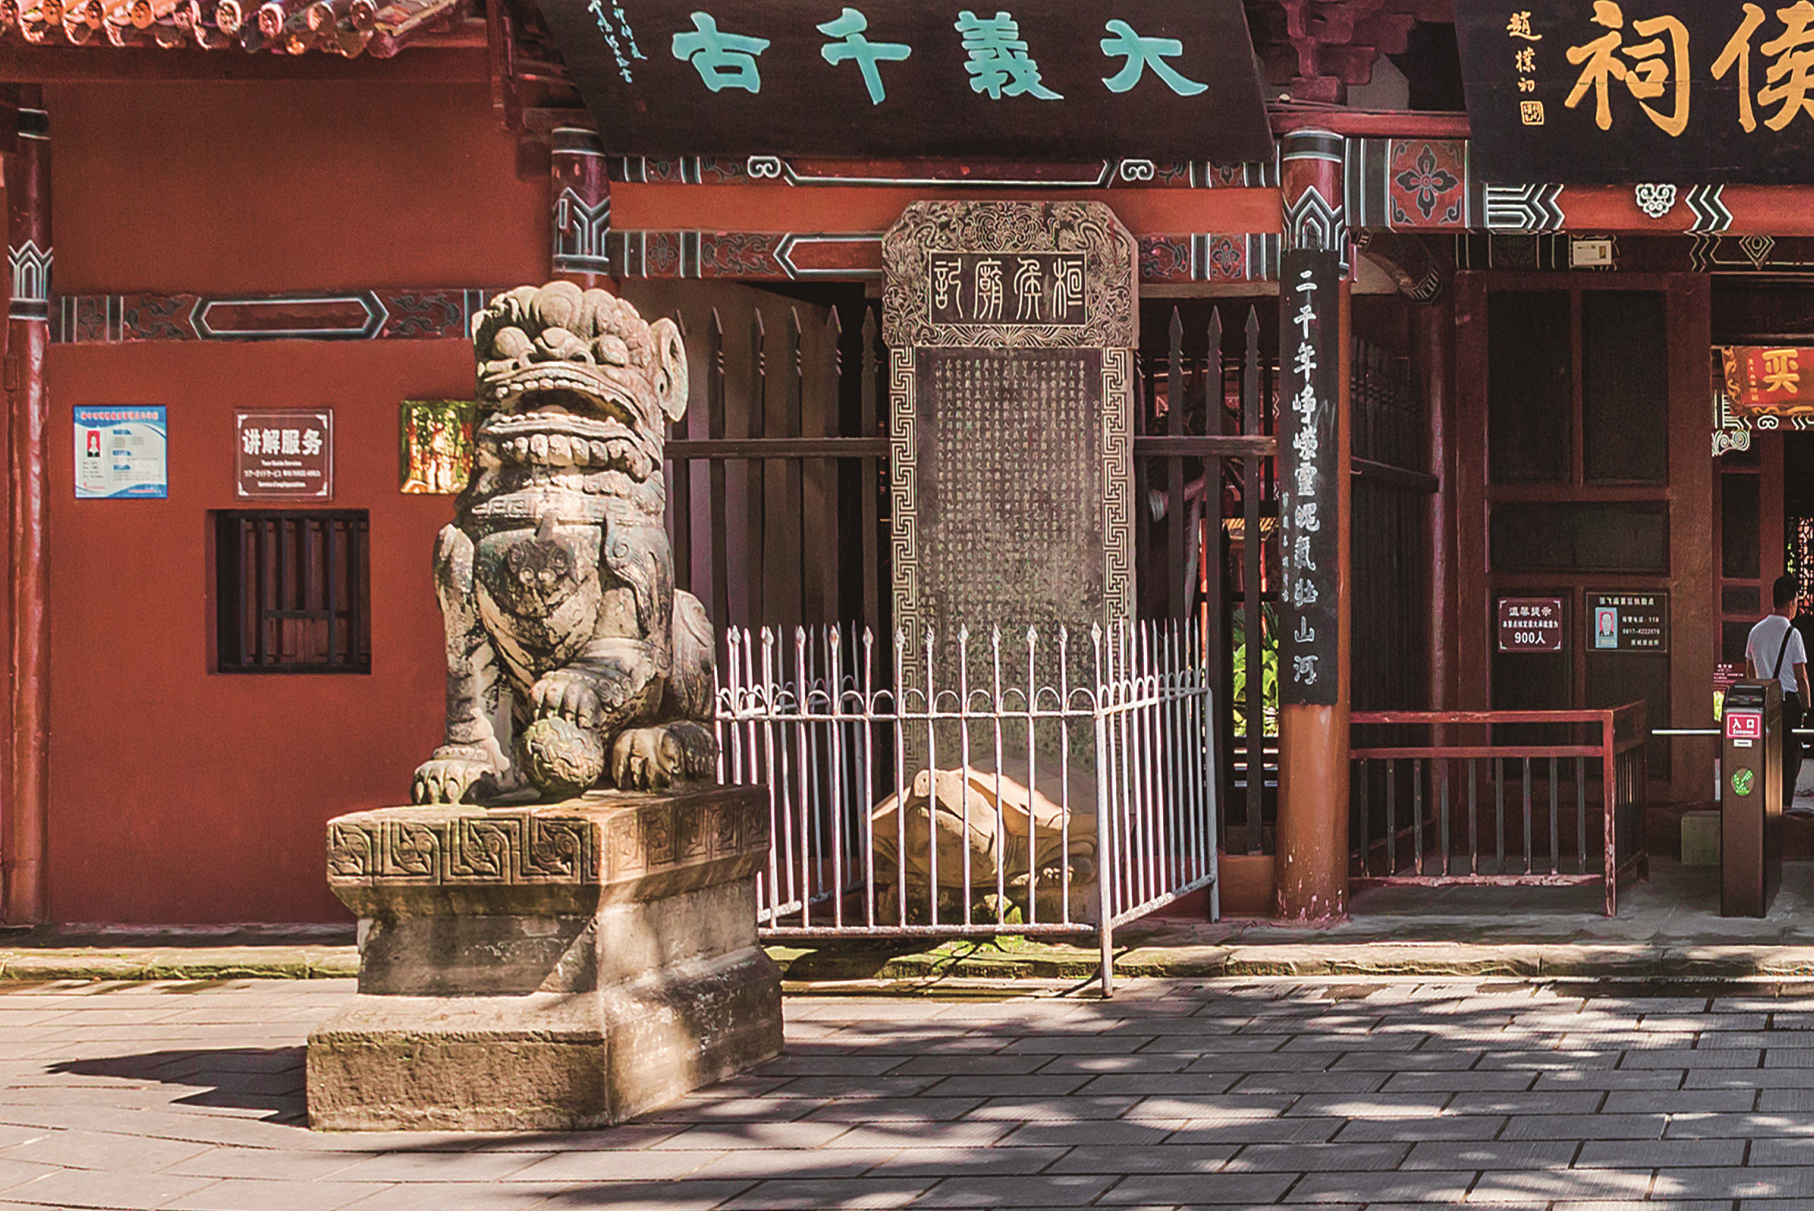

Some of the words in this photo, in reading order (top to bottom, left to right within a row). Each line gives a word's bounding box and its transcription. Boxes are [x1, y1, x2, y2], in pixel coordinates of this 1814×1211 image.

[672, 8, 1208, 105] 大義千古
[1506, 10, 1543, 93] 趙樸初
[241, 428, 323, 455] 讲解服务
[1514, 631, 1546, 644] 900人
[1732, 718, 1755, 729] 入口
